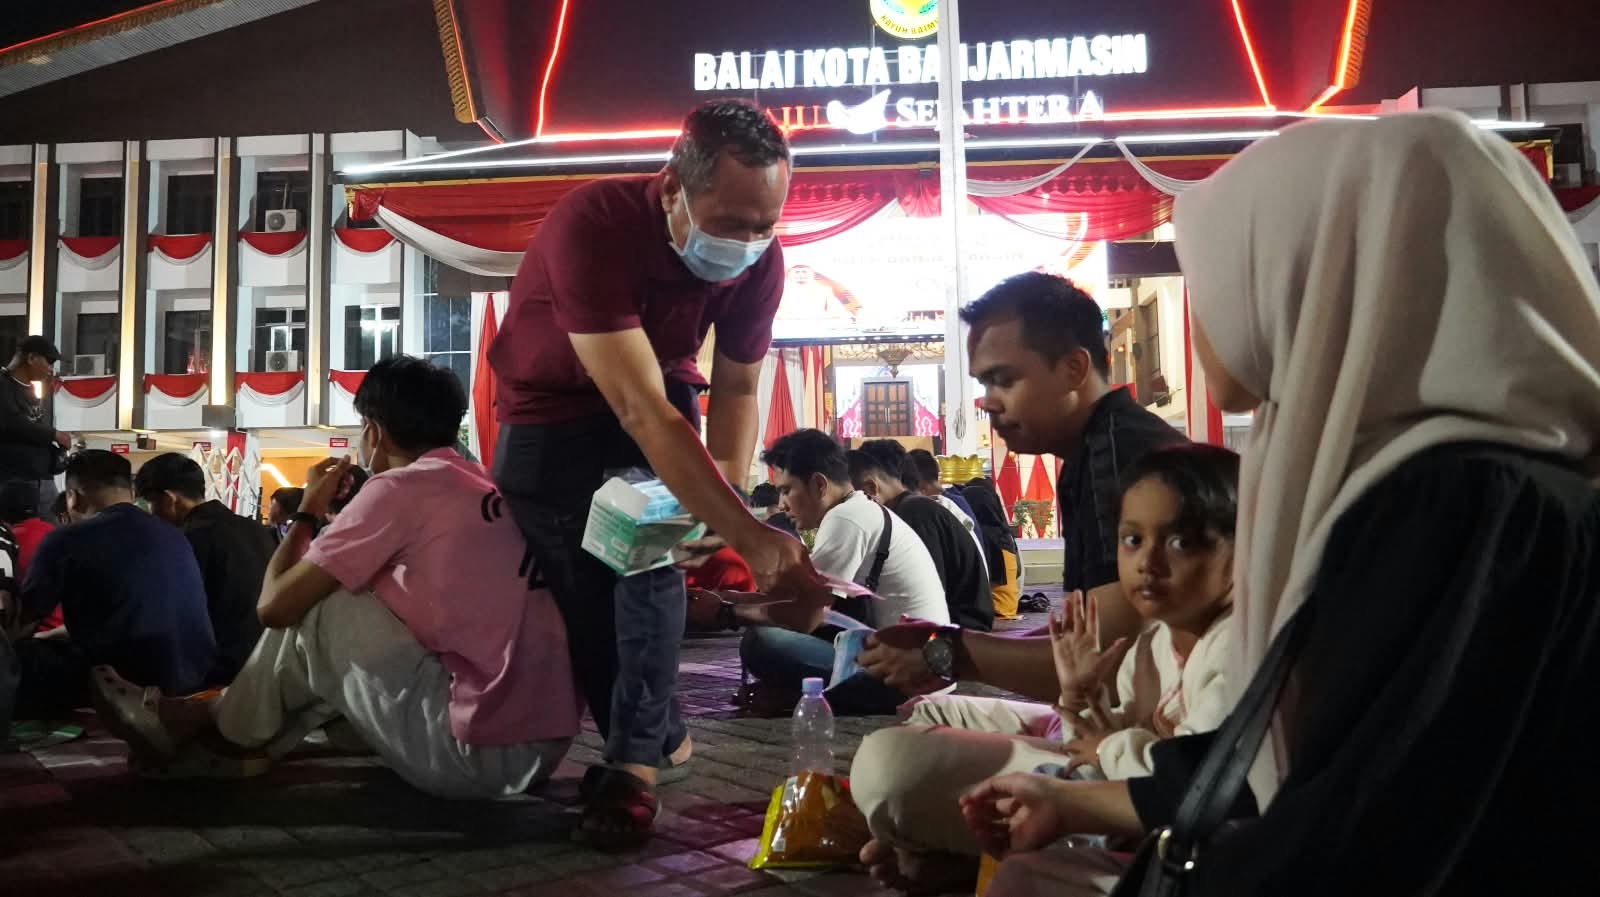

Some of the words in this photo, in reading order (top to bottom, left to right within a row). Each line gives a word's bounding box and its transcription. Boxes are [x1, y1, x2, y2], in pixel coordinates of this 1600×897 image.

[695, 50, 796, 91] BALAI
[803, 47, 890, 88] KOTA
[895, 90, 1104, 127] SEHTERA
